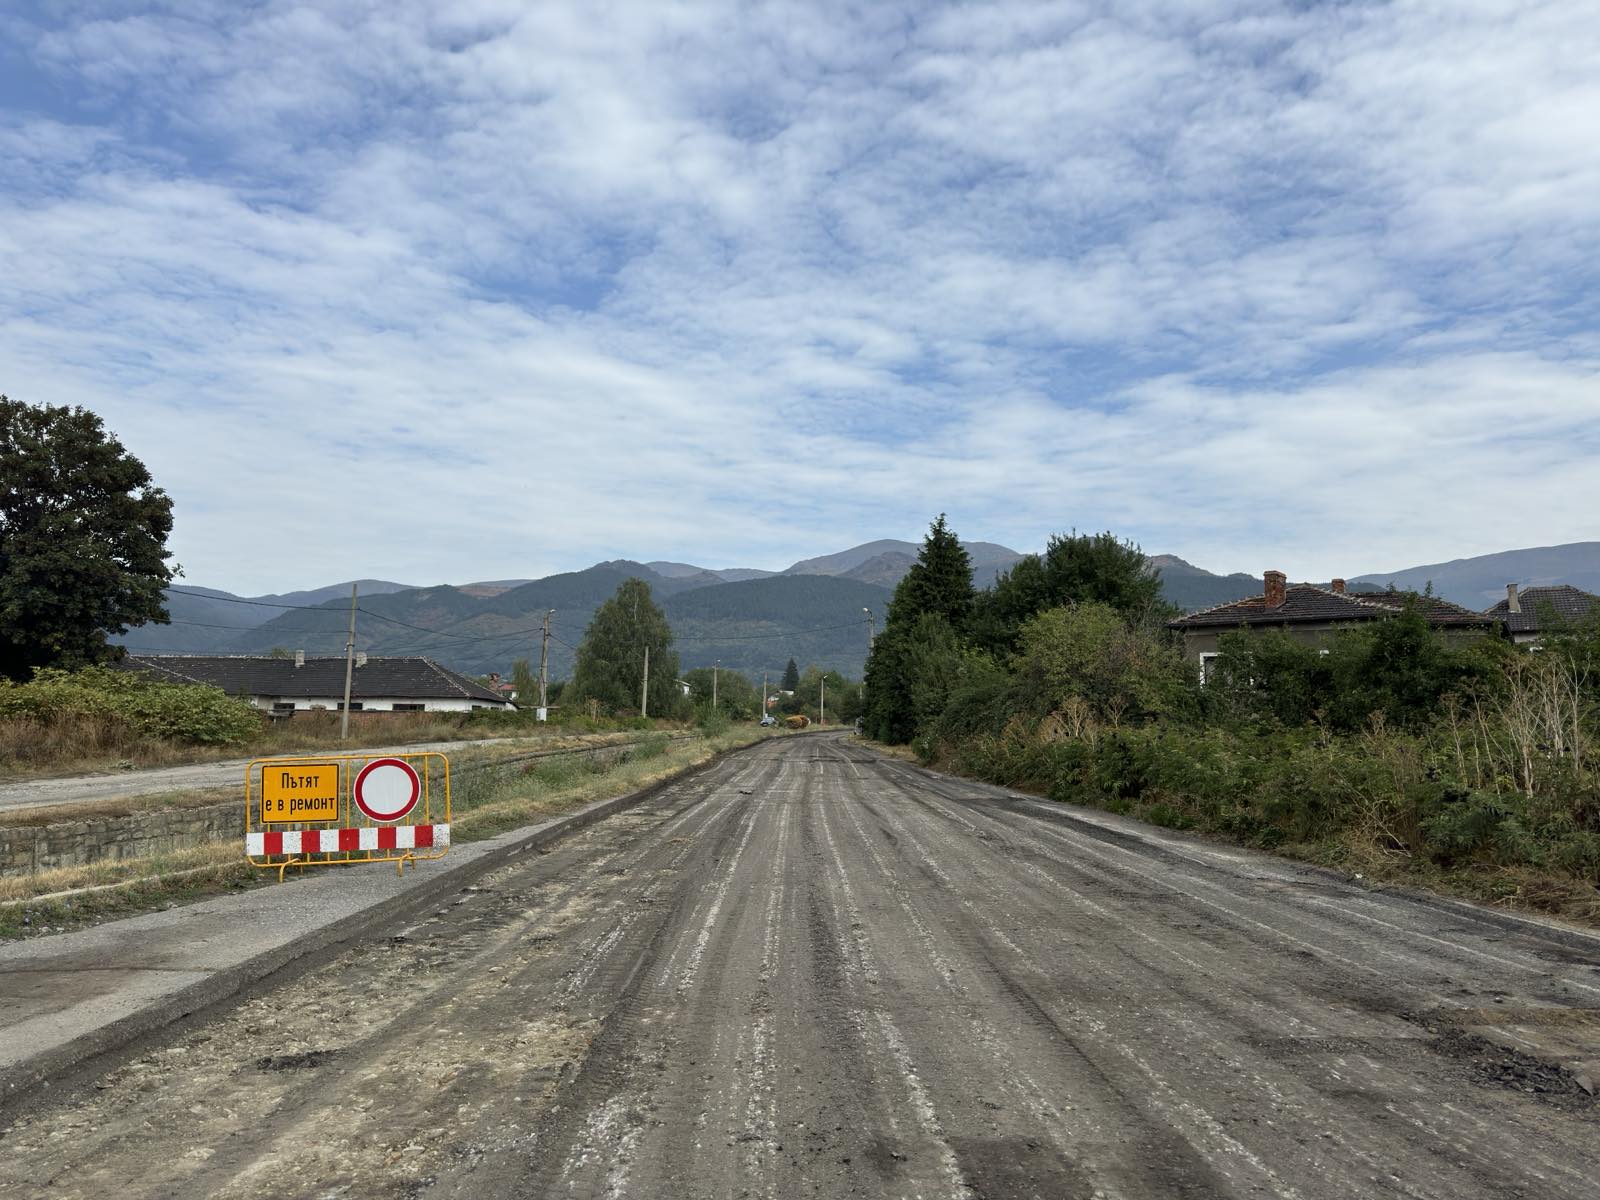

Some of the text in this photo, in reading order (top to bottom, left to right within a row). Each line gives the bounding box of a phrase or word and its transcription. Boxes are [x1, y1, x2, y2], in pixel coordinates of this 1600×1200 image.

[282, 772, 320, 789] Пътят
[265, 797, 335, 815] е в ремонт
